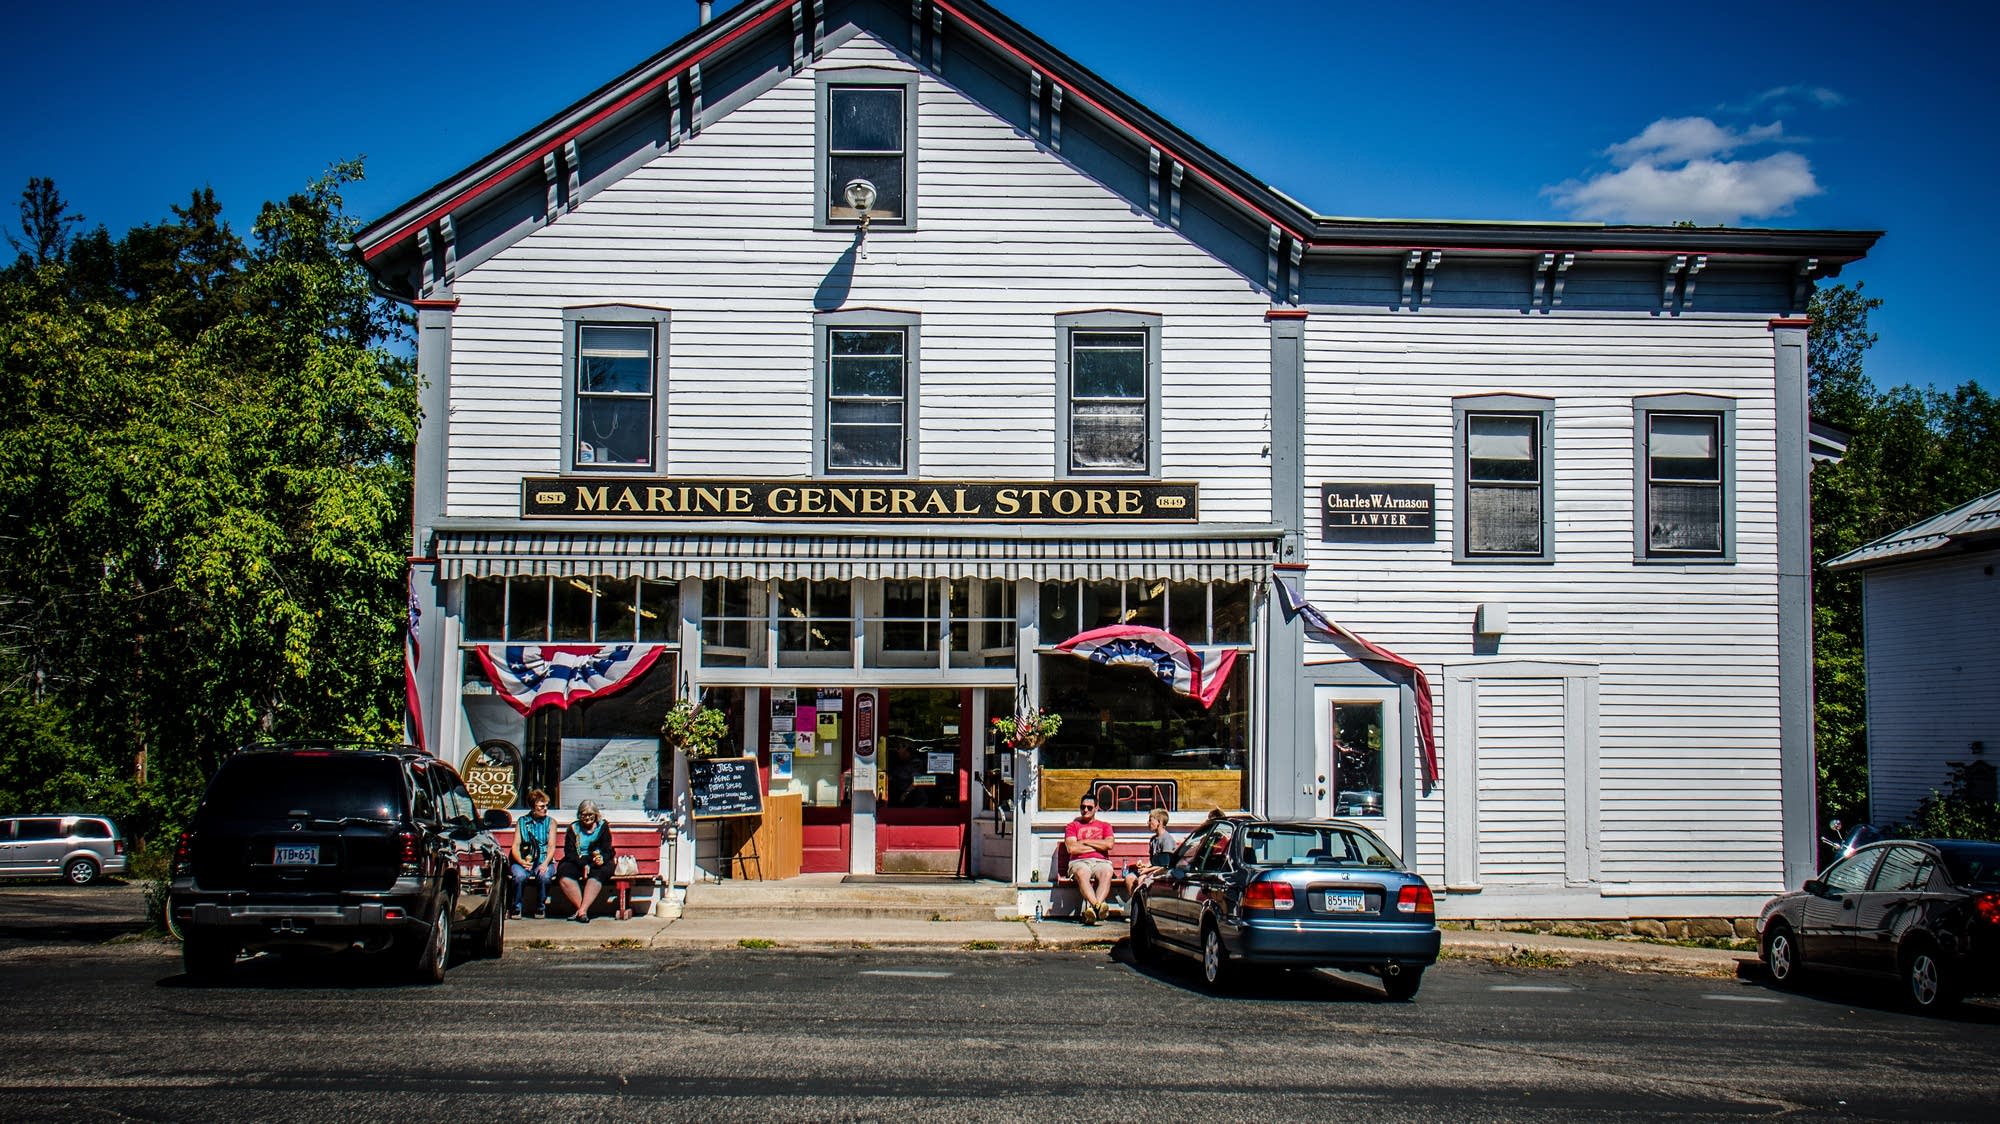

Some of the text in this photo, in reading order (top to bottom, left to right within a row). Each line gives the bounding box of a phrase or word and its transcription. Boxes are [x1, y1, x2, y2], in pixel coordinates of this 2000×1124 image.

[574, 486, 754, 513] MARINE
[767, 487, 982, 514] GENERAL
[994, 488, 1144, 515] STORE
[1327, 493, 1429, 509] Charles W. Arnason
[1351, 514, 1408, 525] LAWYER
[1096, 784, 1172, 812] OPEN
